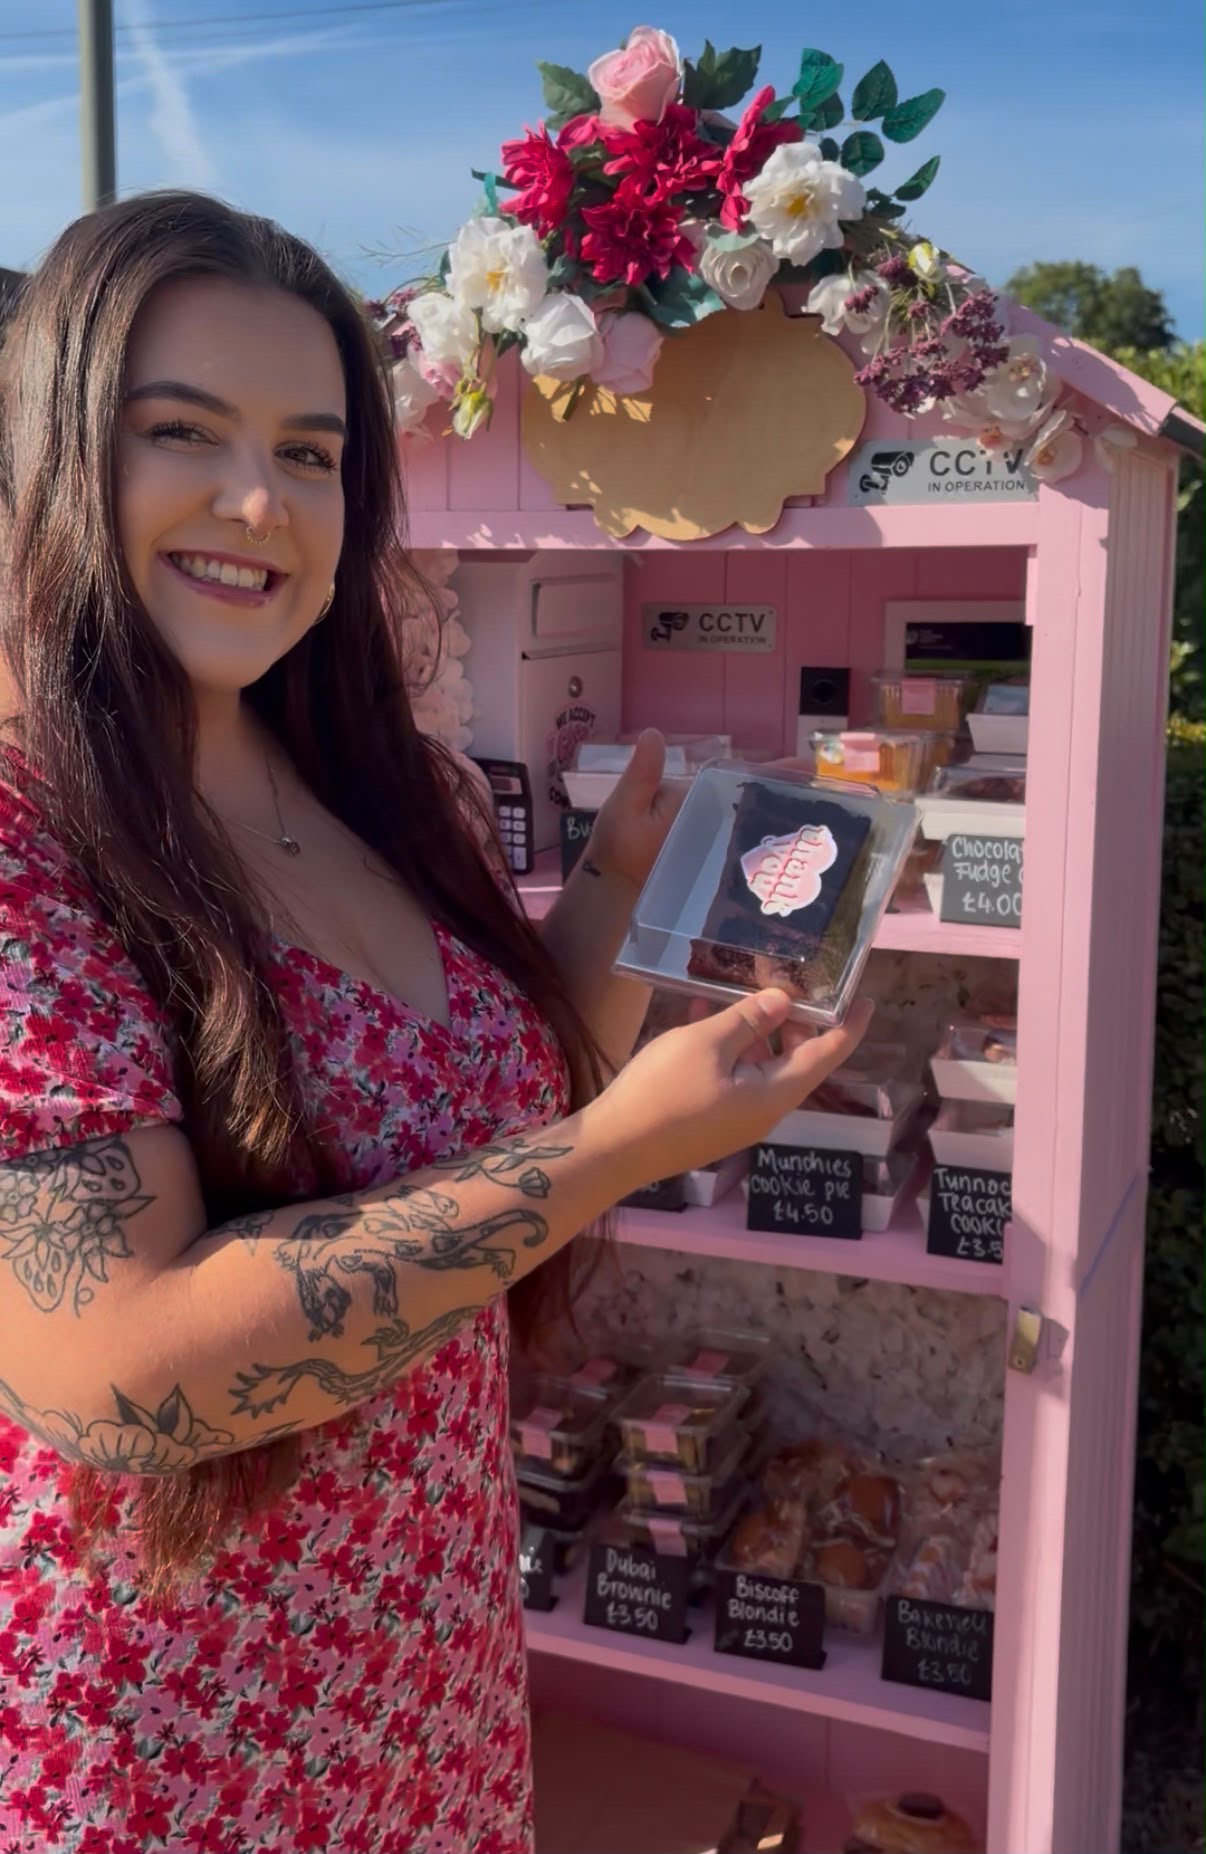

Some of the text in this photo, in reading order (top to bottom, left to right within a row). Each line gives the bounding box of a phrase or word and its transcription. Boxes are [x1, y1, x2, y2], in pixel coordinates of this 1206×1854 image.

[927, 479, 1026, 493] IN OPERATION
[699, 612, 766, 633] CCTV
[951, 836, 1023, 864] Chocola
[953, 860, 1012, 888] Fudge
[963, 891, 1022, 916] £4.00
[757, 1148, 852, 1178] Munchies
[933, 1167, 1012, 1197] Tunnoc
[773, 1200, 834, 1225] £4.50
[937, 1192, 1012, 1218] Teacak
[957, 1236, 1004, 1258] £3.5
[606, 1547, 656, 1580] Dubai
[597, 1572, 672, 1609] Brownie
[735, 1575, 800, 1603] Biscoff
[728, 1598, 800, 1627] Blondie
